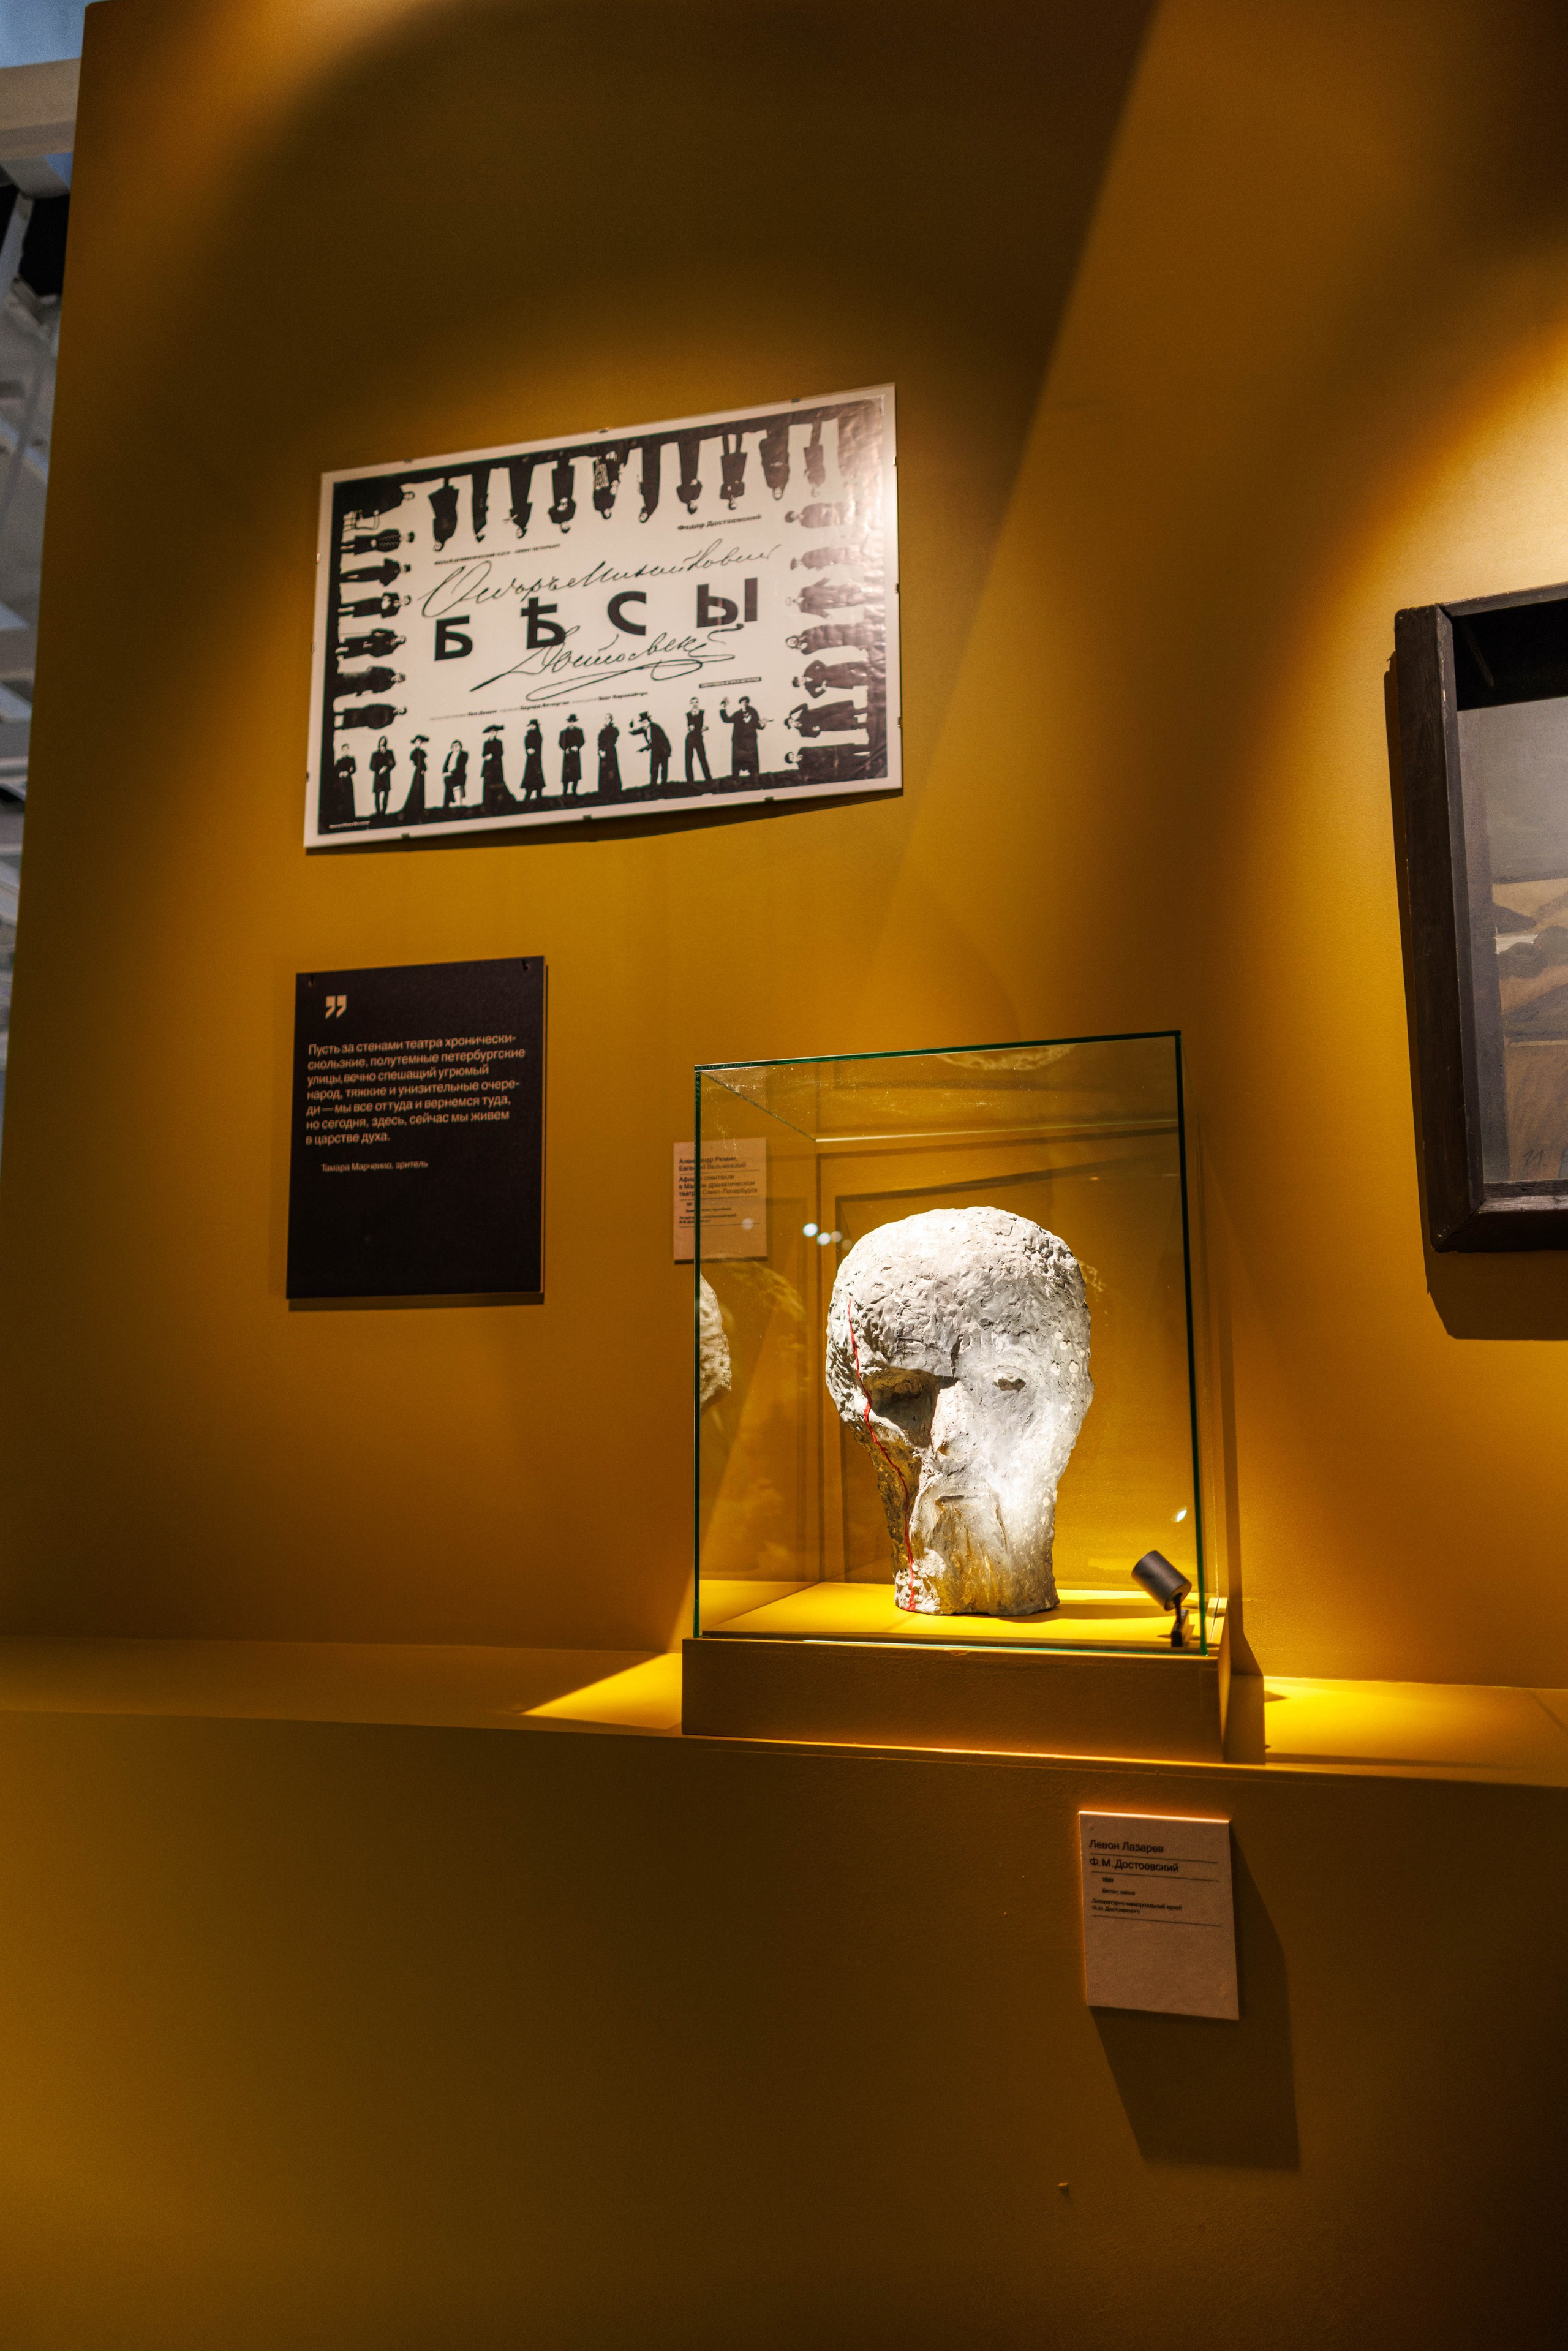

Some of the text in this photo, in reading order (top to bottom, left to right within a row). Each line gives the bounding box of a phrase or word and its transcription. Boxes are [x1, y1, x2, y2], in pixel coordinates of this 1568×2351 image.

[308, 1034, 517, 1058] Пусть за стенами театра хронически-
[307, 1048, 526, 1071] скользкие, полутемные петербургские
[307, 1063, 489, 1089] улицы, вечно спешащий угрюмый
[307, 1079, 520, 1102] народ, тяжкие и унизительные очере-
[334, 1103, 352, 1114] мы
[353, 1102, 373, 1112] все
[375, 1100, 413, 1113] оттуда
[415, 1100, 422, 1109] и
[424, 1096, 480, 1111] вернемся
[481, 1095, 511, 1109] туда,
[306, 1111, 510, 1130] но сегодня, здесь, сейчас мы живем
[306, 1131, 390, 1147] в царстве духа.
[320, 1163, 350, 1173] Тамара
[395, 1160, 429, 1169] зритель
[1088, 1840, 1164, 1854] Левон Лазарев
[1114, 1859, 1179, 1873] Достоевский
